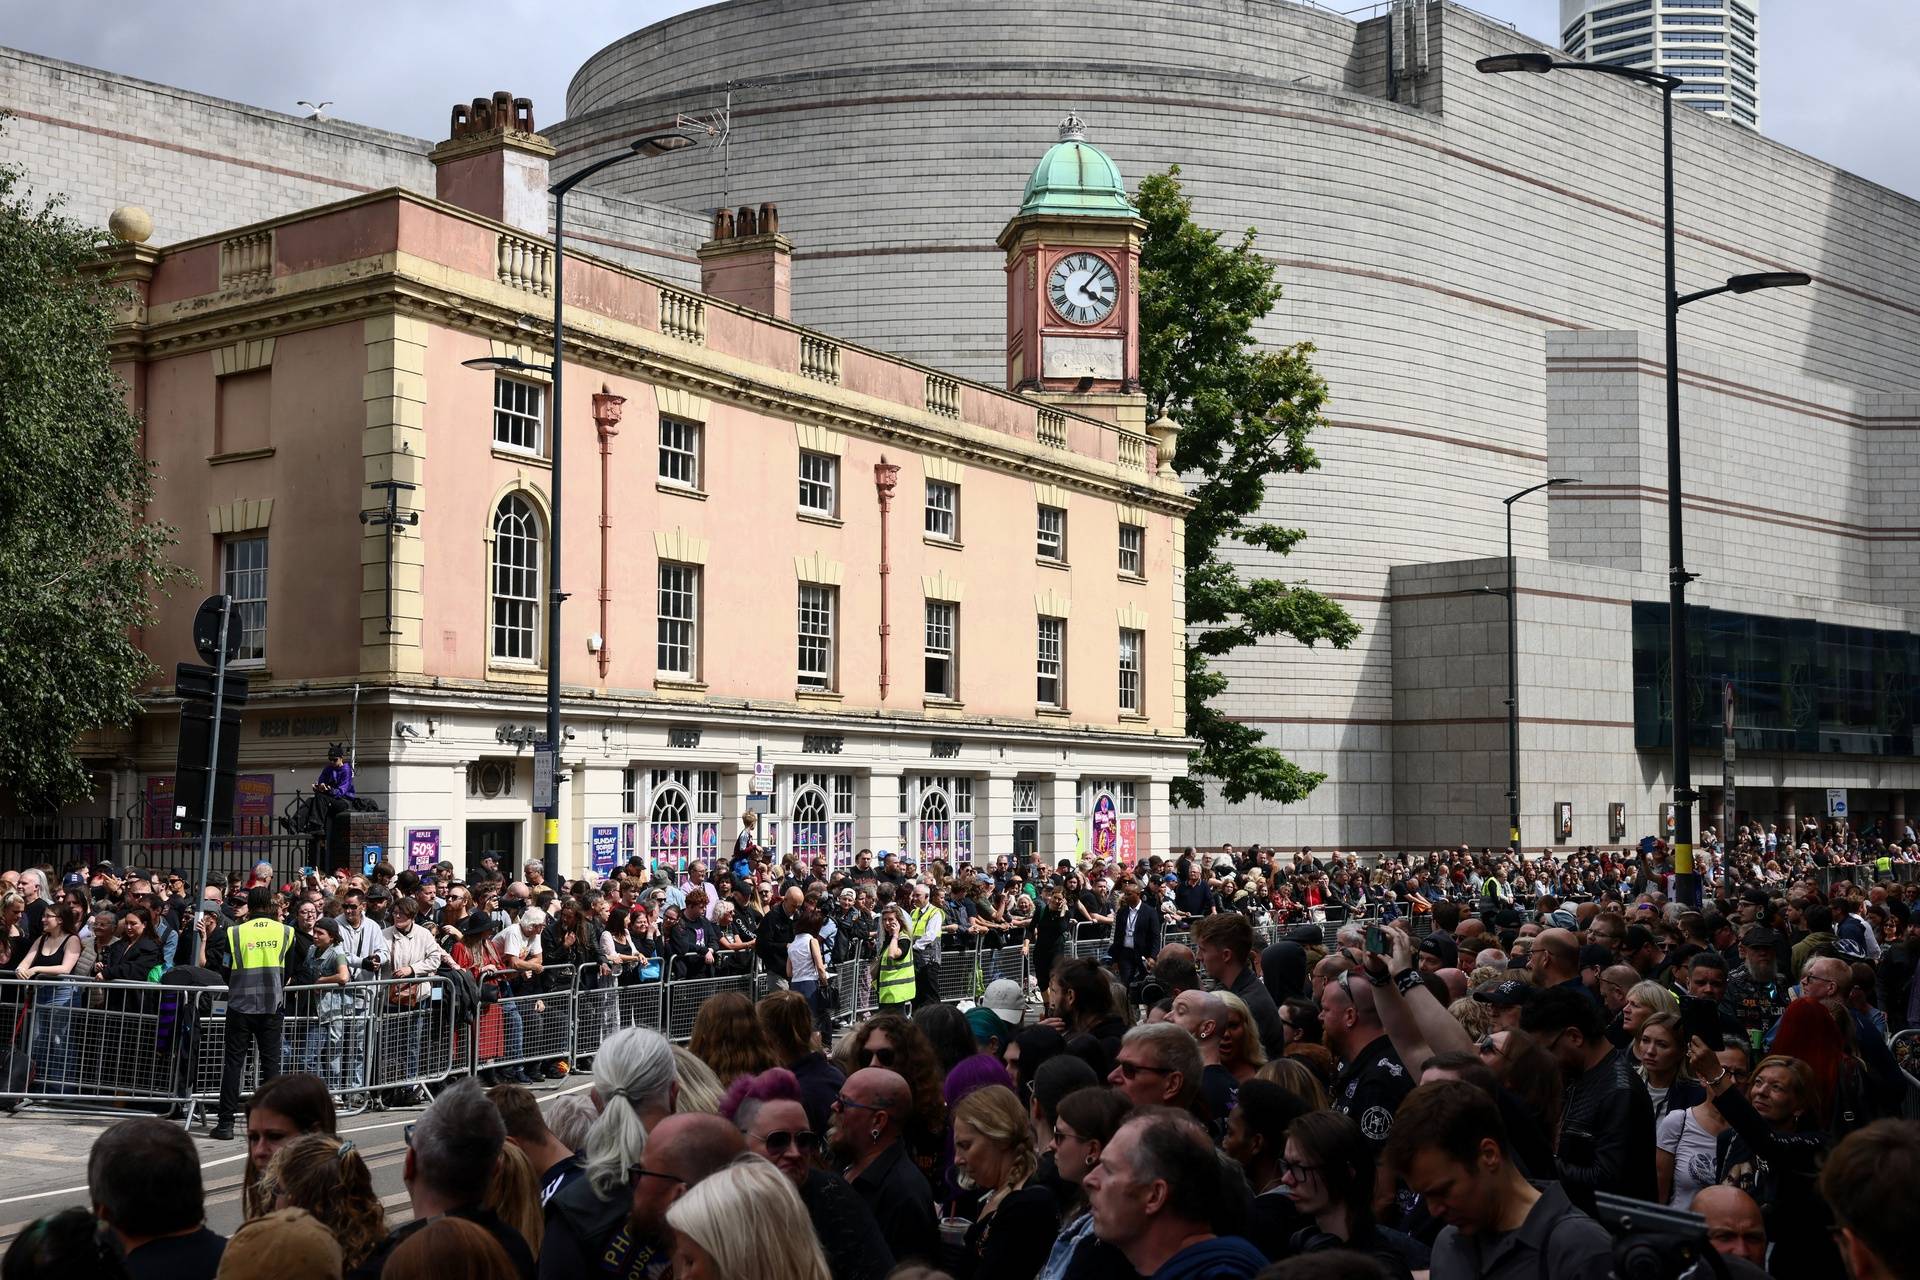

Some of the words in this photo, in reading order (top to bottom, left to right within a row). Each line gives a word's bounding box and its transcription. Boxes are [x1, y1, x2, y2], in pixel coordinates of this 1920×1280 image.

[802, 735, 845, 754] DANCE
[593, 837, 617, 845] SUNDAY
[412, 842, 434, 856] 50%
